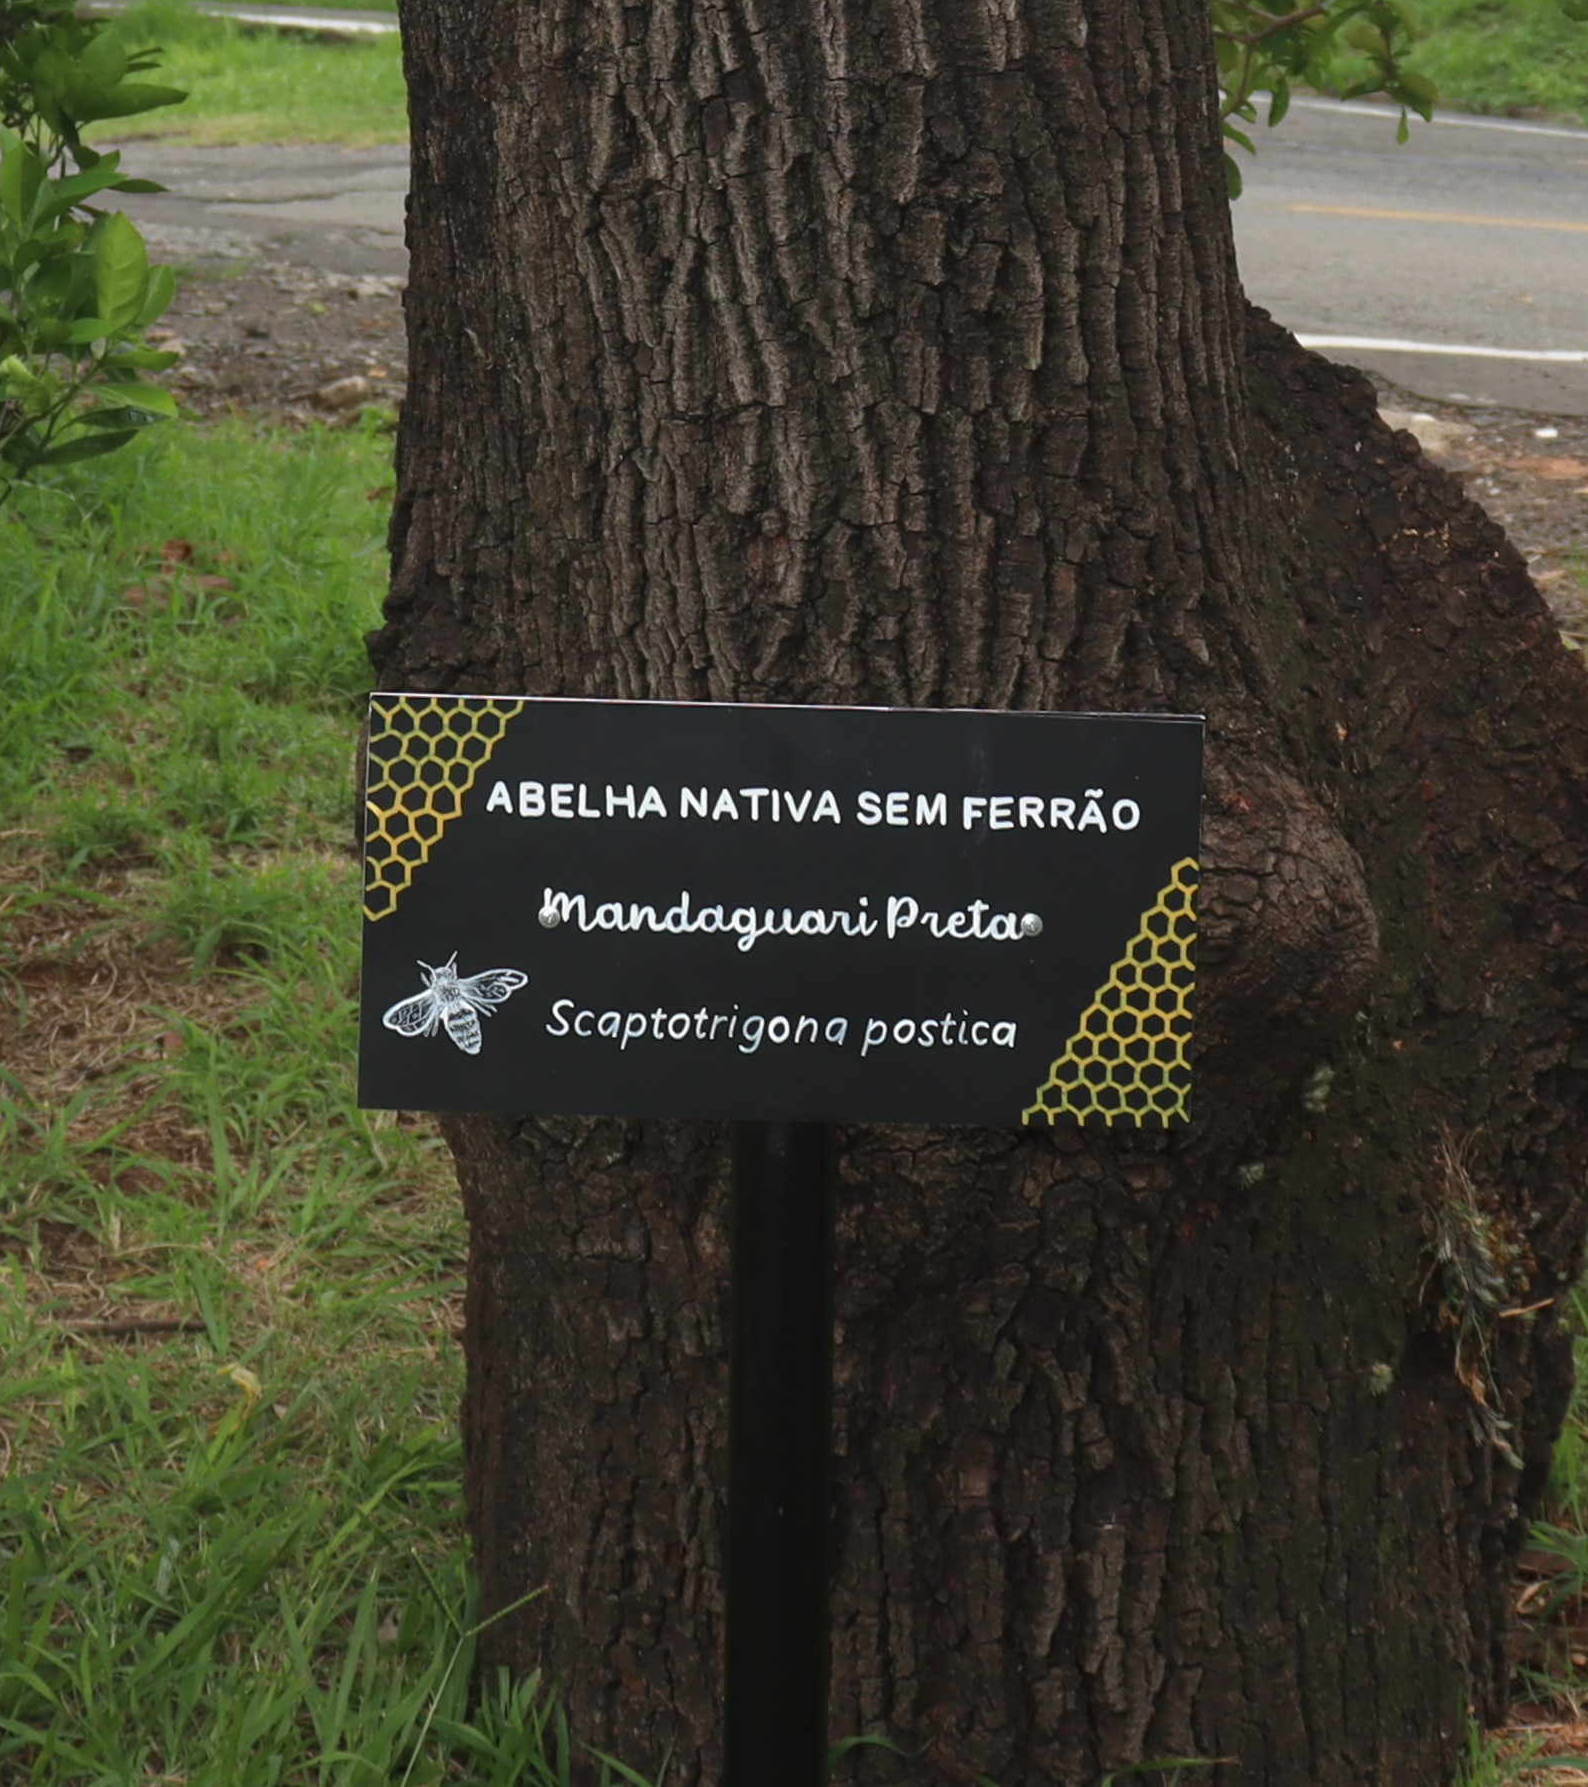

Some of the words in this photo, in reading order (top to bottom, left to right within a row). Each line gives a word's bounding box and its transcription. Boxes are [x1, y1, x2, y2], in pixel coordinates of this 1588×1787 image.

[485, 780, 668, 819] ABELHA
[680, 786, 841, 824] NATIVA
[856, 790, 947, 826] SEM
[962, 788, 1141, 834] FERRÃO
[539, 887, 879, 952] Mandaguari
[886, 895, 1025, 941] Preta
[545, 998, 848, 1054] Scaptotrigona
[860, 1009, 1017, 1057] postica
